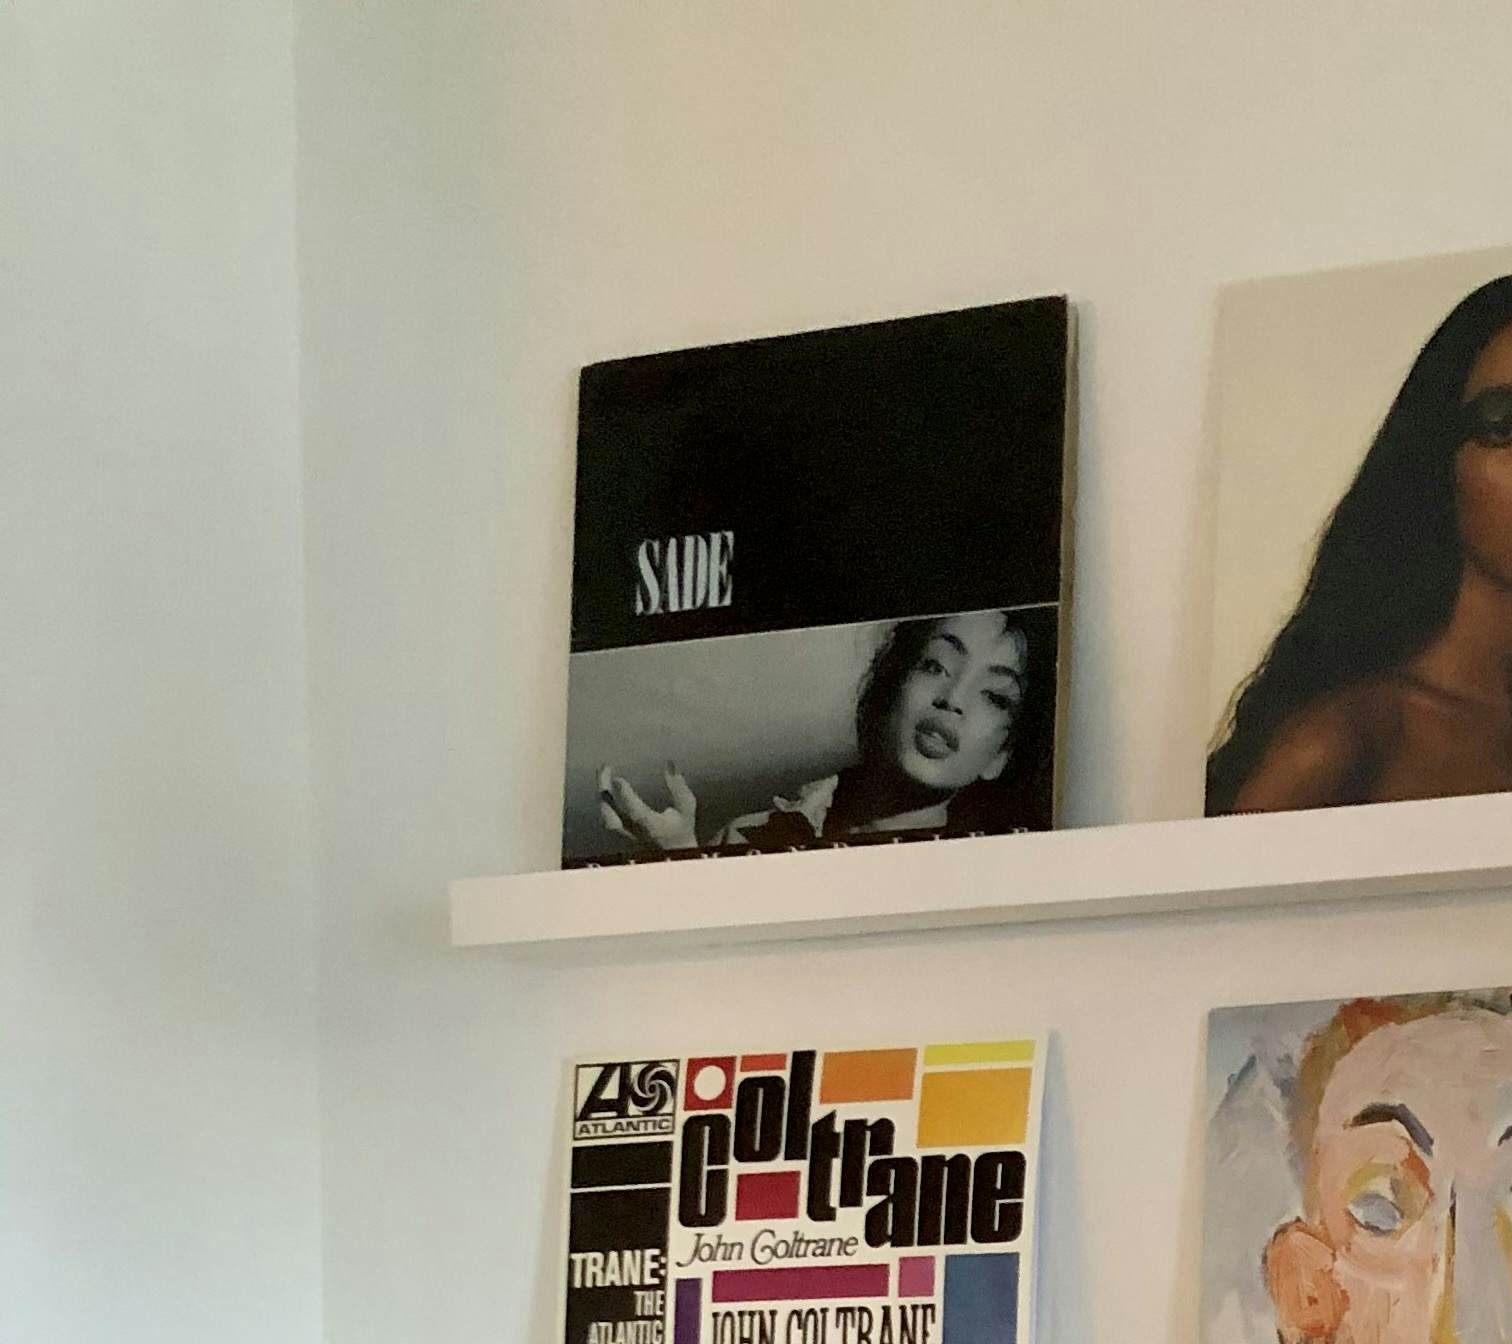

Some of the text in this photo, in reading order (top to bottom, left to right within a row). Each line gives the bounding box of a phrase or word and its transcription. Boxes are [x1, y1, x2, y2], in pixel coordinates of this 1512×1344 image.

[635, 530, 734, 615] SADE
[577, 1119, 672, 1137] ATLANTIC
[570, 1248, 667, 1288] TRANE:
[676, 1229, 859, 1268] John Coltrane
[633, 1290, 664, 1316] THE
